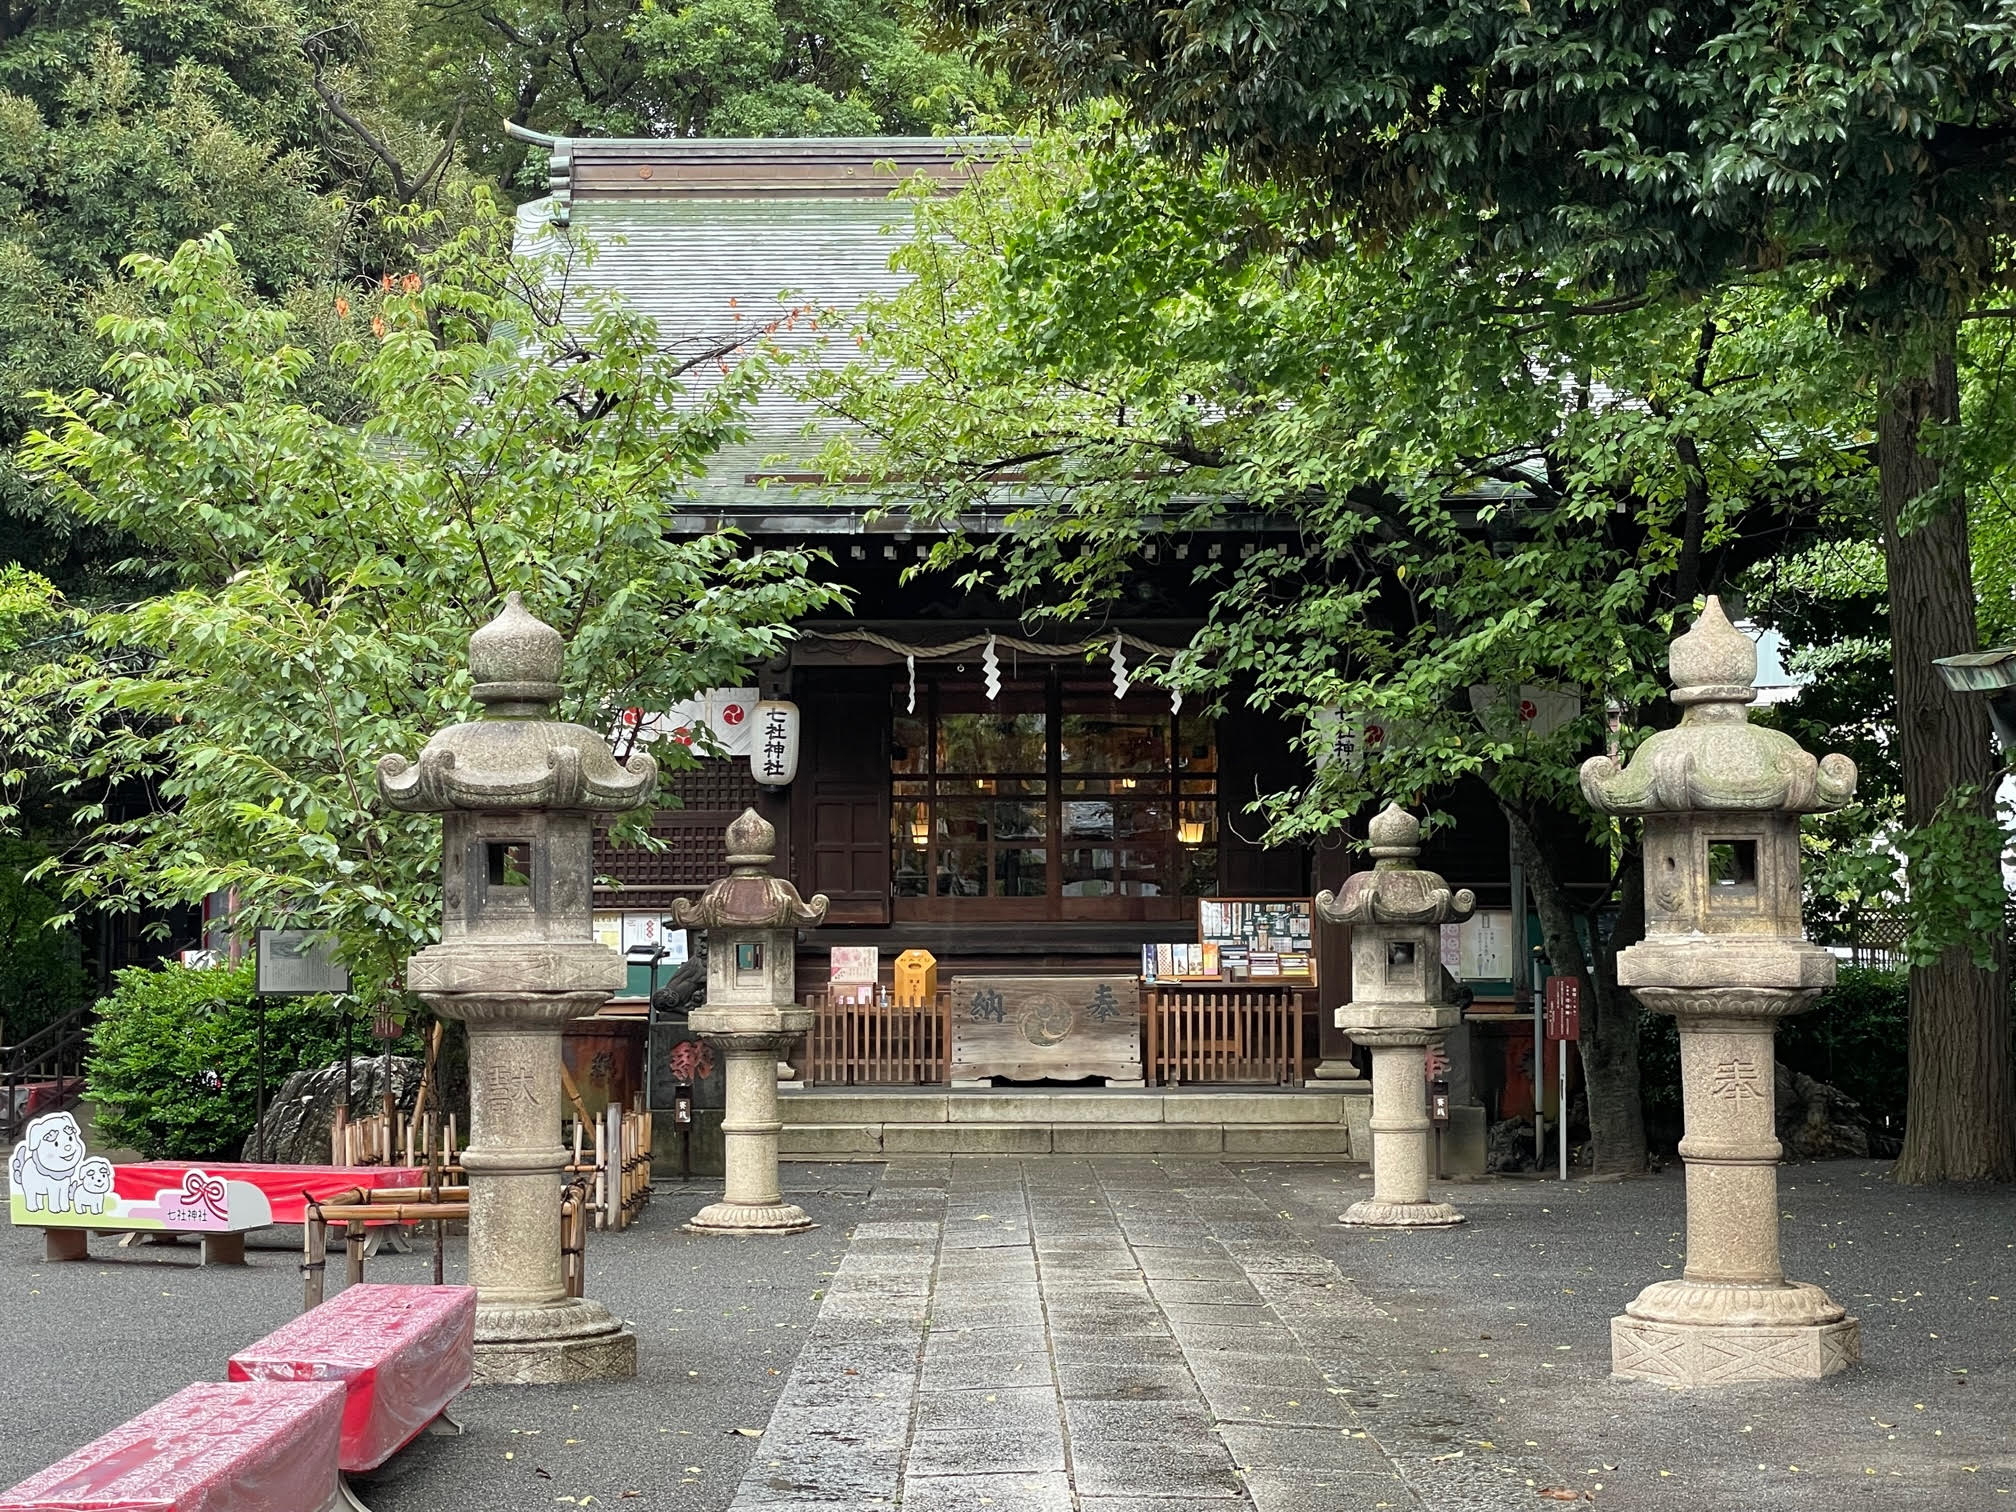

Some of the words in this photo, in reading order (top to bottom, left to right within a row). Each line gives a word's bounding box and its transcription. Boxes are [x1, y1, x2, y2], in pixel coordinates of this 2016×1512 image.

[763, 707, 787, 777] 七社神社
[1711, 1058, 1765, 1114] 奉
[167, 1209, 208, 1222] 七社神社
